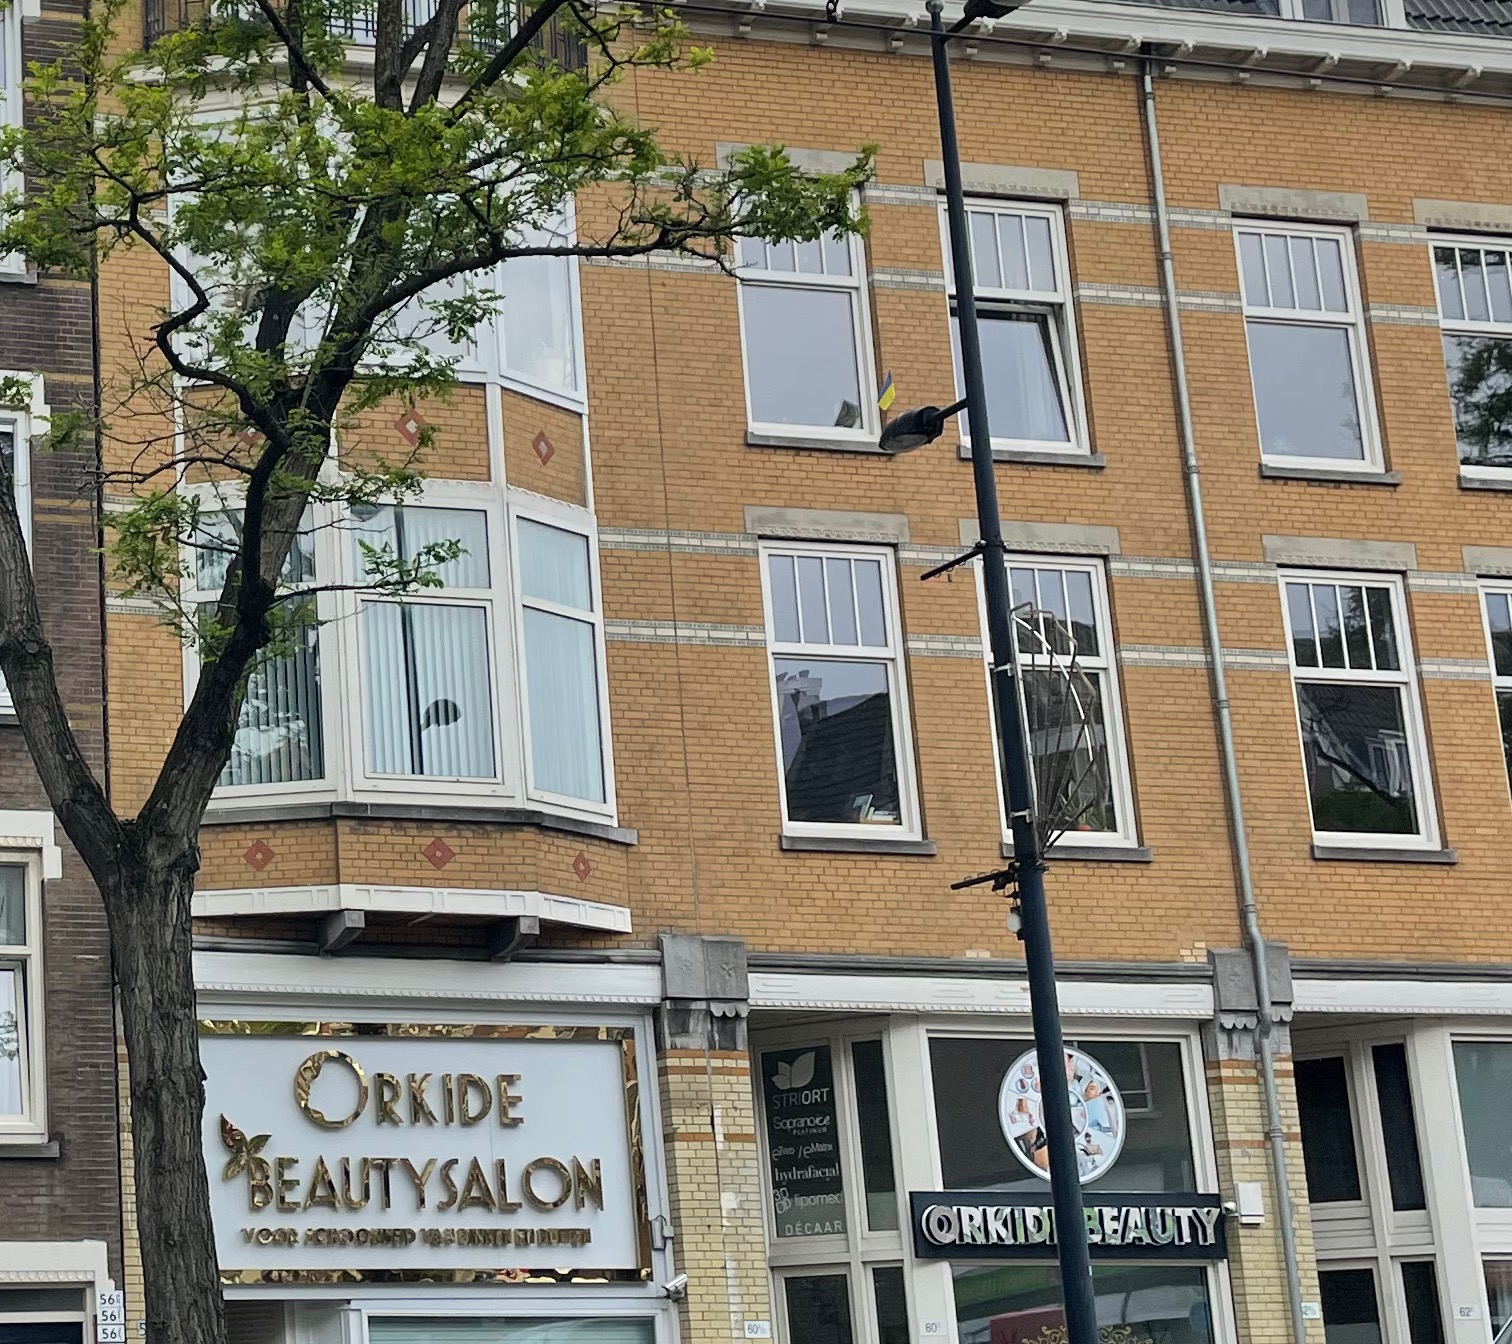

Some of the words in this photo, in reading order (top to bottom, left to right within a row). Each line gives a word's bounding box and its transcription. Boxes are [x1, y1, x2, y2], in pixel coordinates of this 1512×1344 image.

[294, 1049, 525, 1130] ORKIDE
[772, 1087, 830, 1110] STRIORT
[247, 1155, 605, 1212] BEAUTYSALON
[1083, 1206, 1221, 1245] BEAUTY
